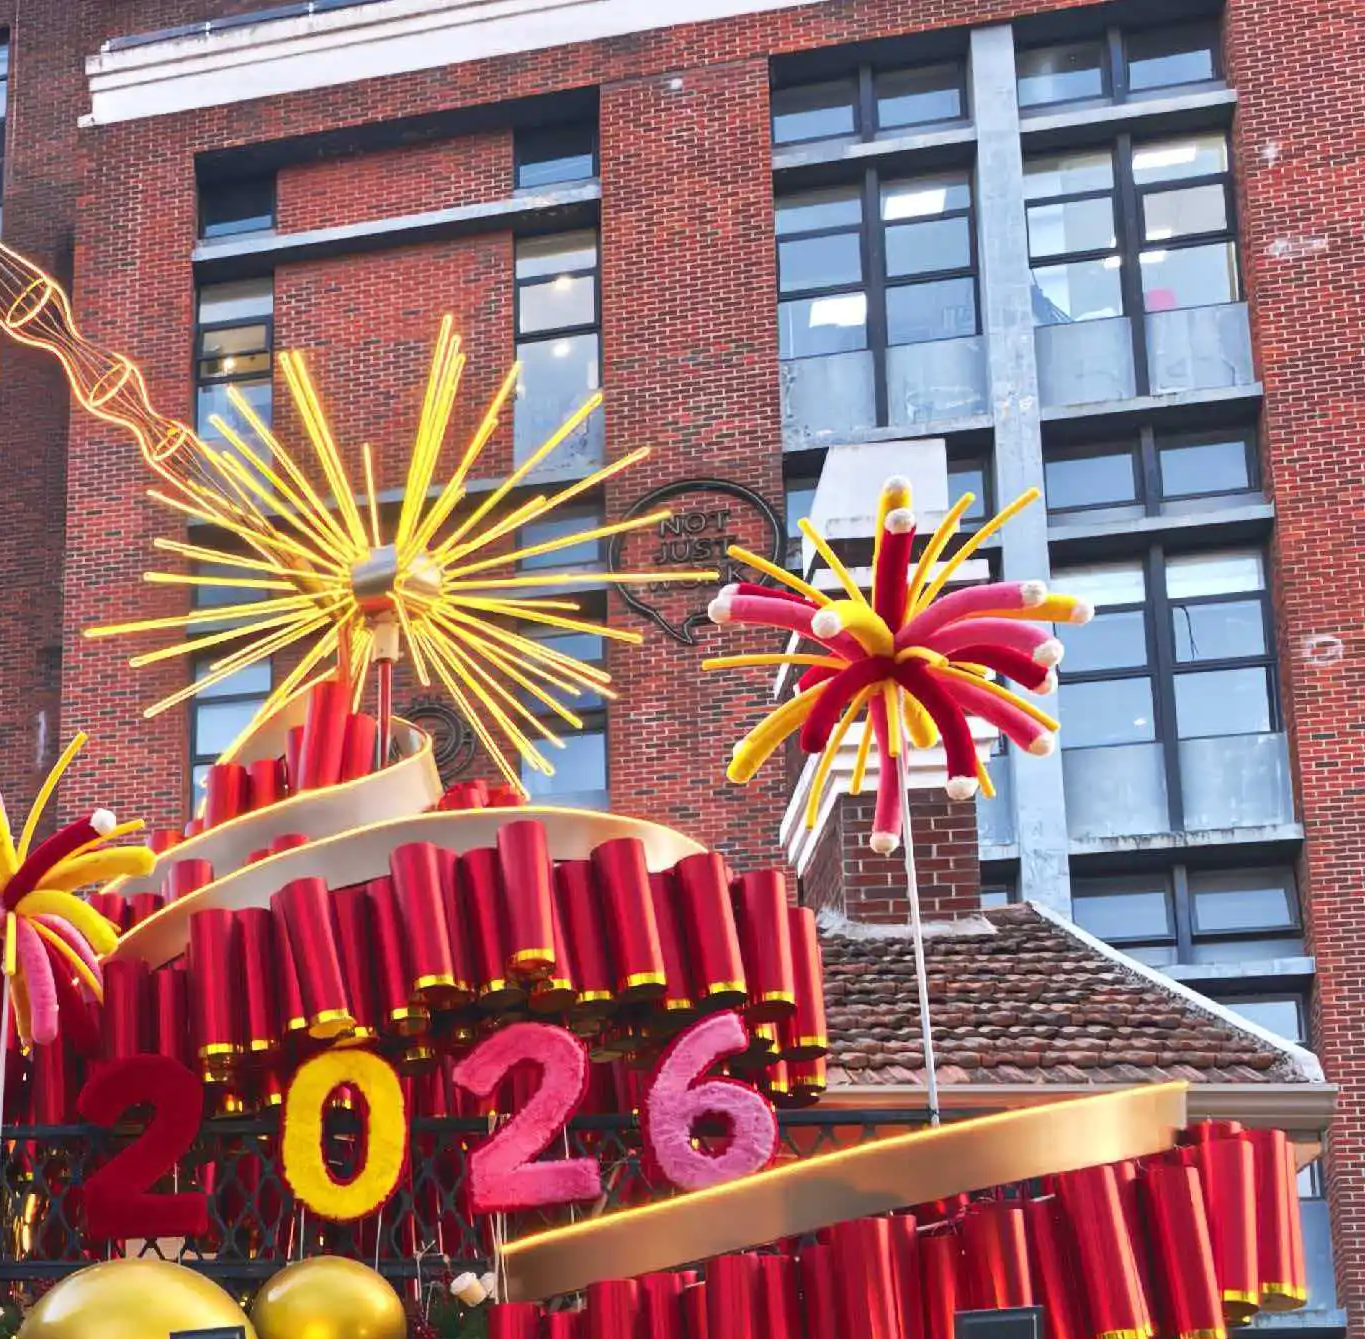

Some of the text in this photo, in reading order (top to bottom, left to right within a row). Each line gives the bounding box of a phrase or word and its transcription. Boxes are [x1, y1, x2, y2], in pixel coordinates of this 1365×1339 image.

[659, 510, 731, 537] NOT
[655, 536, 736, 564] JUST
[78, 1009, 779, 1239] 2026
